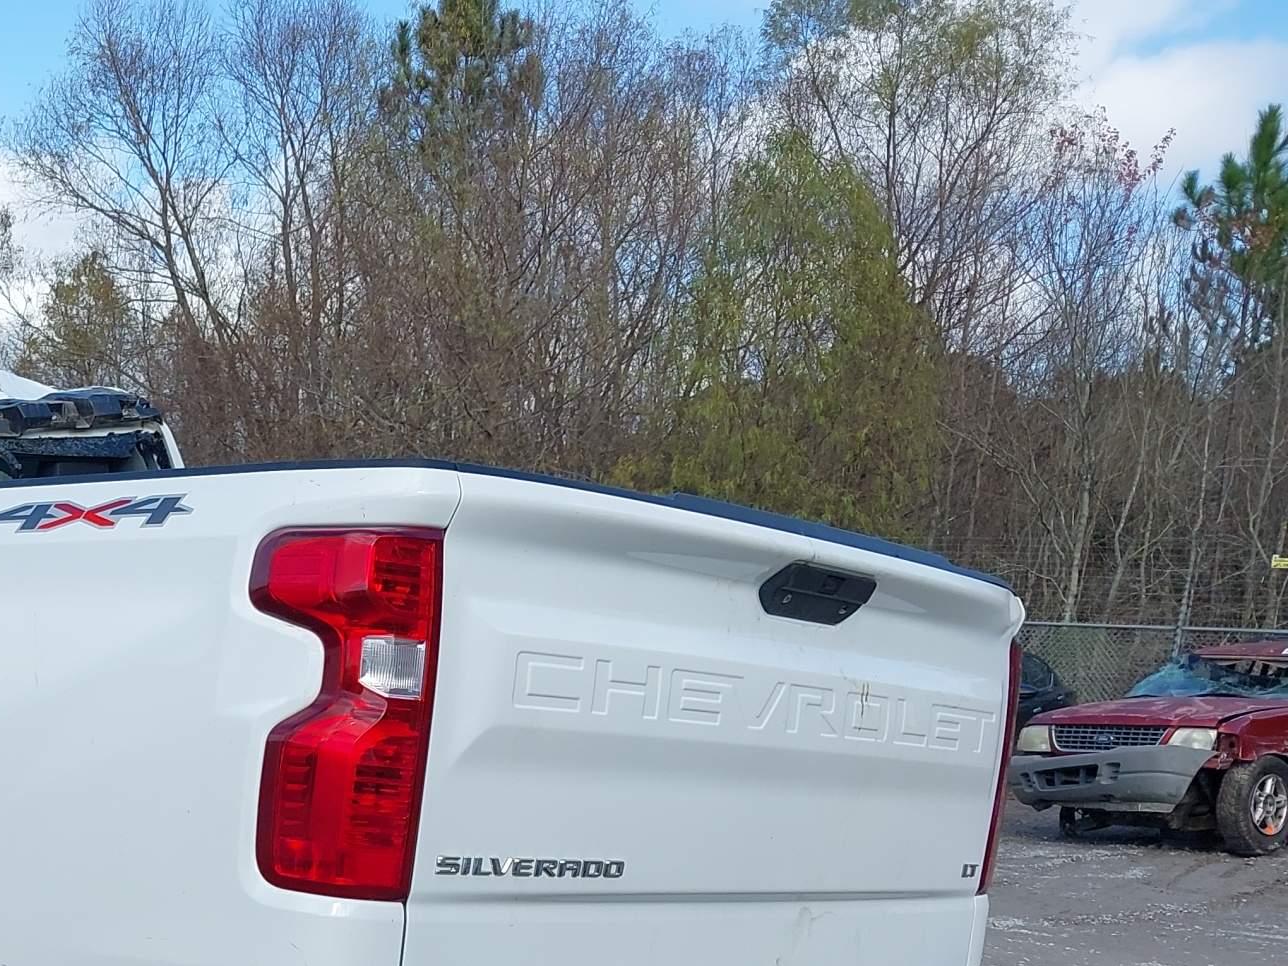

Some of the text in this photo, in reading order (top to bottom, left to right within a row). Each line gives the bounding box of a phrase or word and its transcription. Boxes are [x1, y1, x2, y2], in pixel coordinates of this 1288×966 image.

[513, 650, 996, 753] CHEVROLET
[435, 855, 626, 879] SILVERADO
[961, 863, 979, 878] LT
